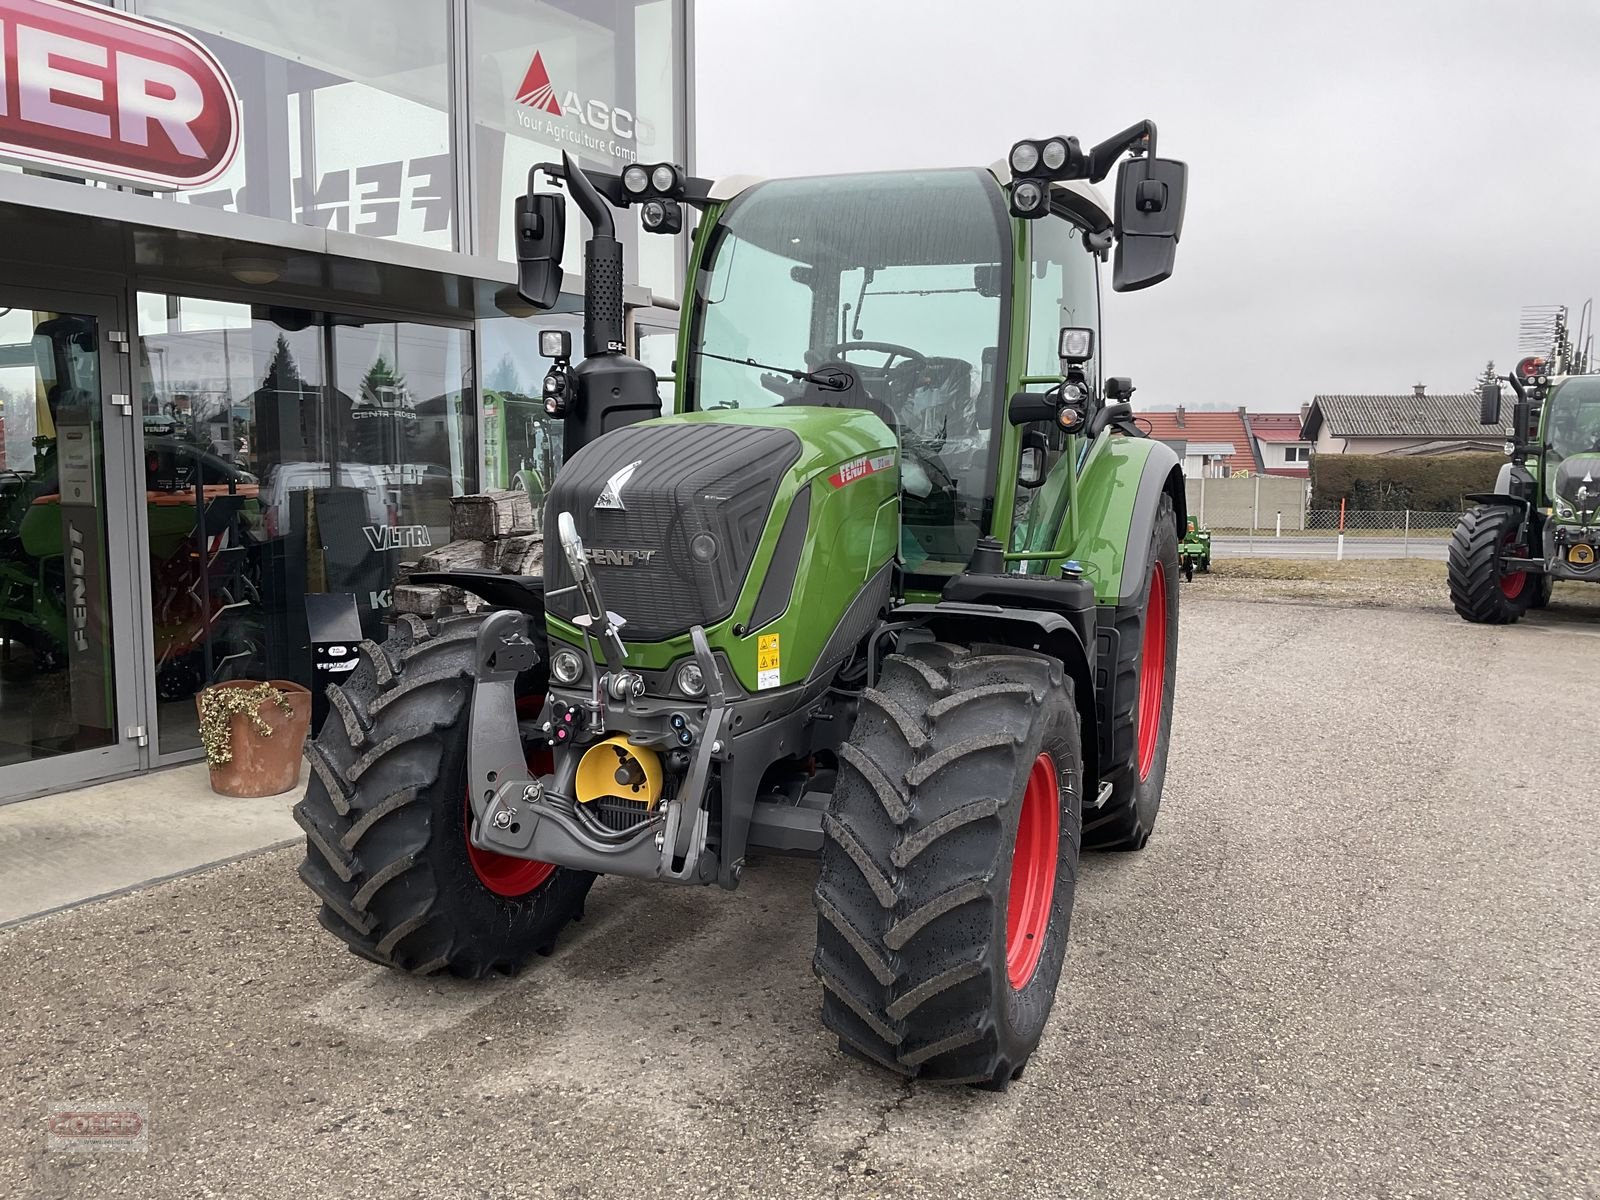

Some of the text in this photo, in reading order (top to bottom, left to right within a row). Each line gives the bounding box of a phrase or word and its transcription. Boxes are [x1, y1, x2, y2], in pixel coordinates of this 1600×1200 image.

[0, 19, 210, 161] ER
[562, 90, 656, 147] AGCO
[516, 109, 542, 131] Your
[545, 120, 606, 152] Agriculture
[839, 455, 867, 483] FENDT
[69, 520, 88, 652] FENDT
